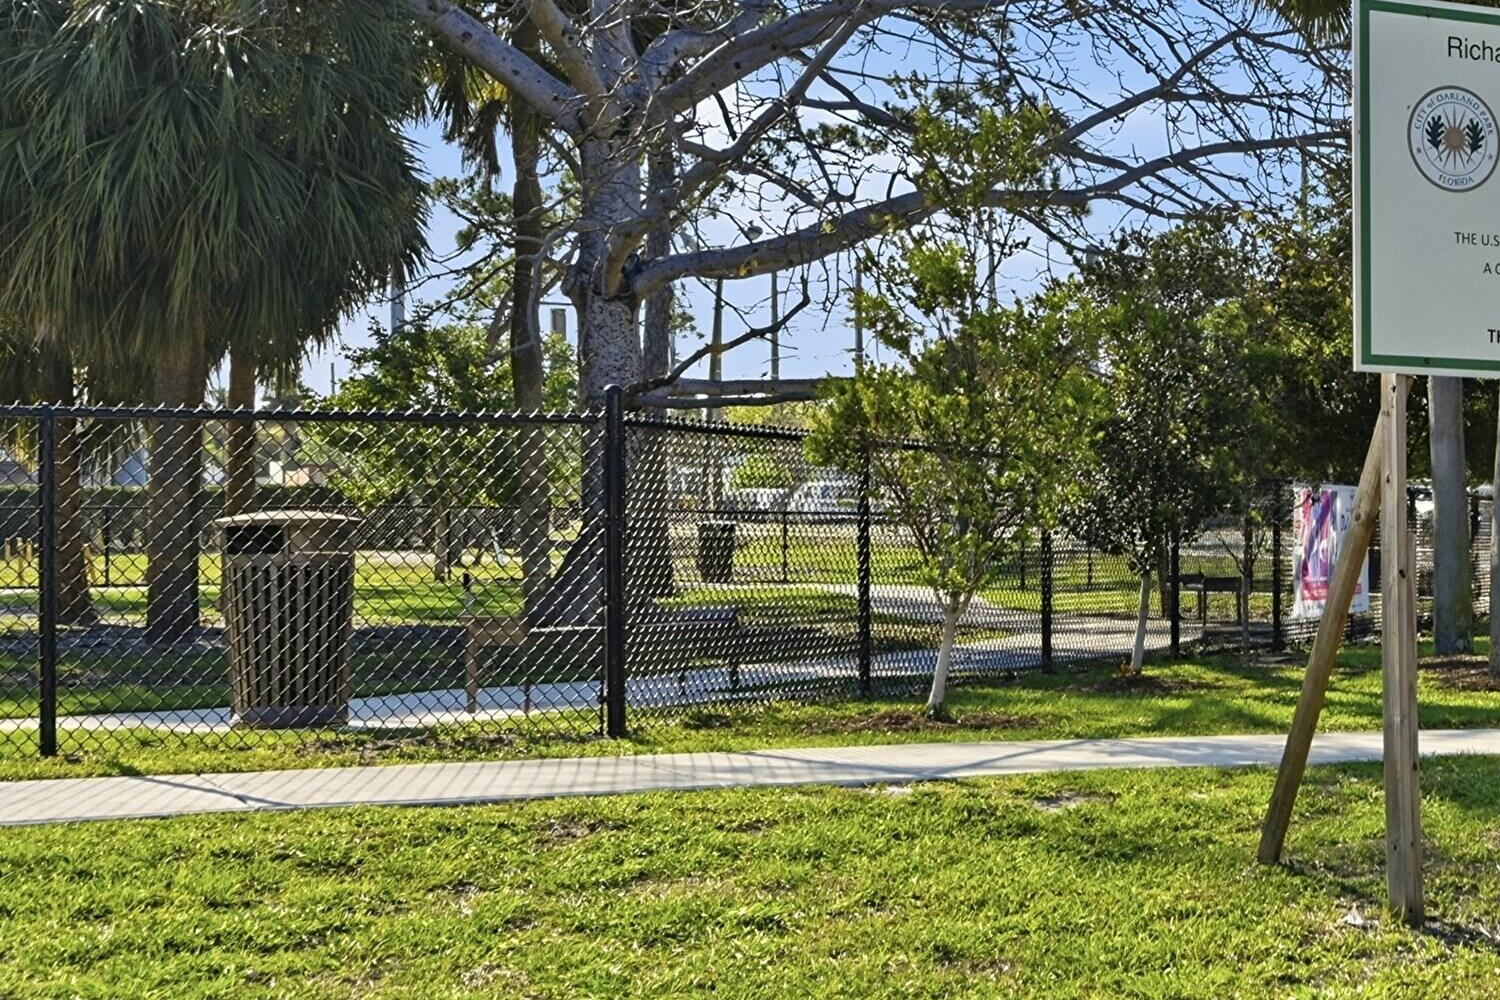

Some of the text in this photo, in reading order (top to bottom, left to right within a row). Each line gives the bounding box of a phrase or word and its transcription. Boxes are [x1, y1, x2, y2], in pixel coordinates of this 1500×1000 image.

[1414, 109, 1427, 130] CITY
[1436, 92, 1480, 111] OAKLAND
[1439, 174, 1474, 187] FLORIDA
[1454, 231, 1477, 245] THE
[1483, 262, 1492, 274] A
